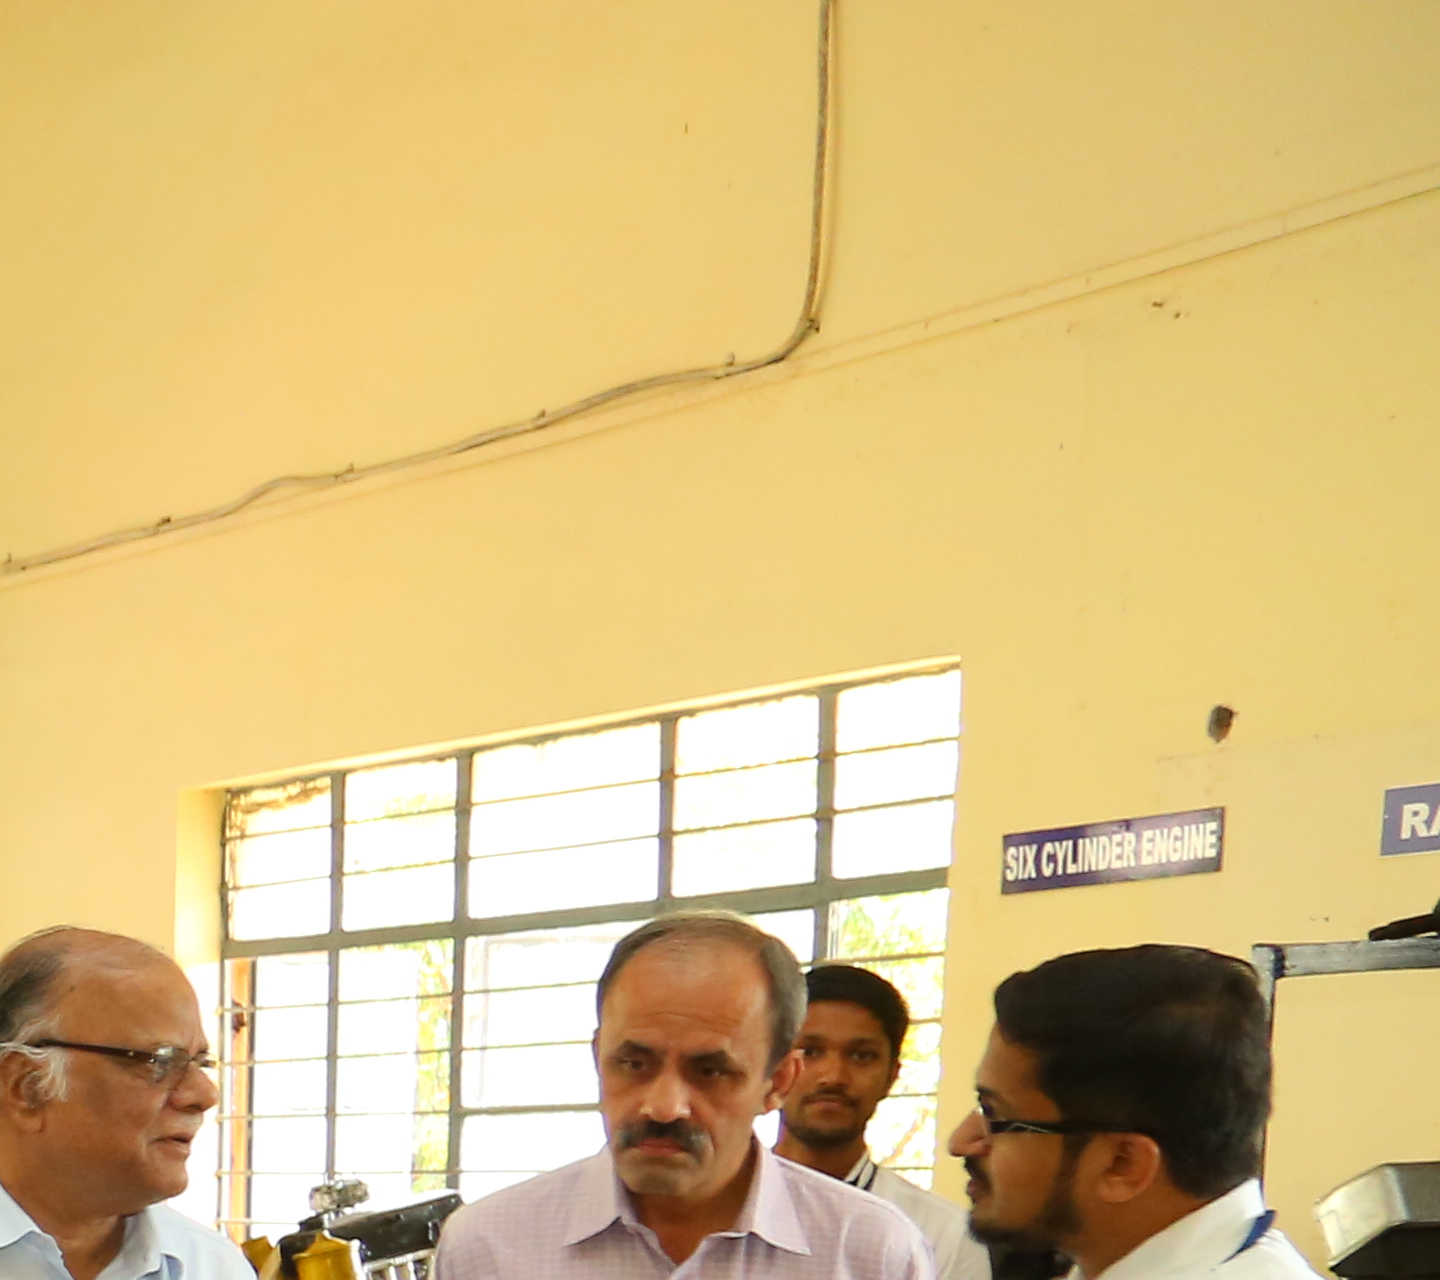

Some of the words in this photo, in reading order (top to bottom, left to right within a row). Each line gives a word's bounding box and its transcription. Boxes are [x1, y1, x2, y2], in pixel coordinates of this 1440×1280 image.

[1005, 838, 1038, 882] SIX
[1041, 833, 1137, 878] CYLINDER
[1140, 821, 1219, 865] ENGINE
